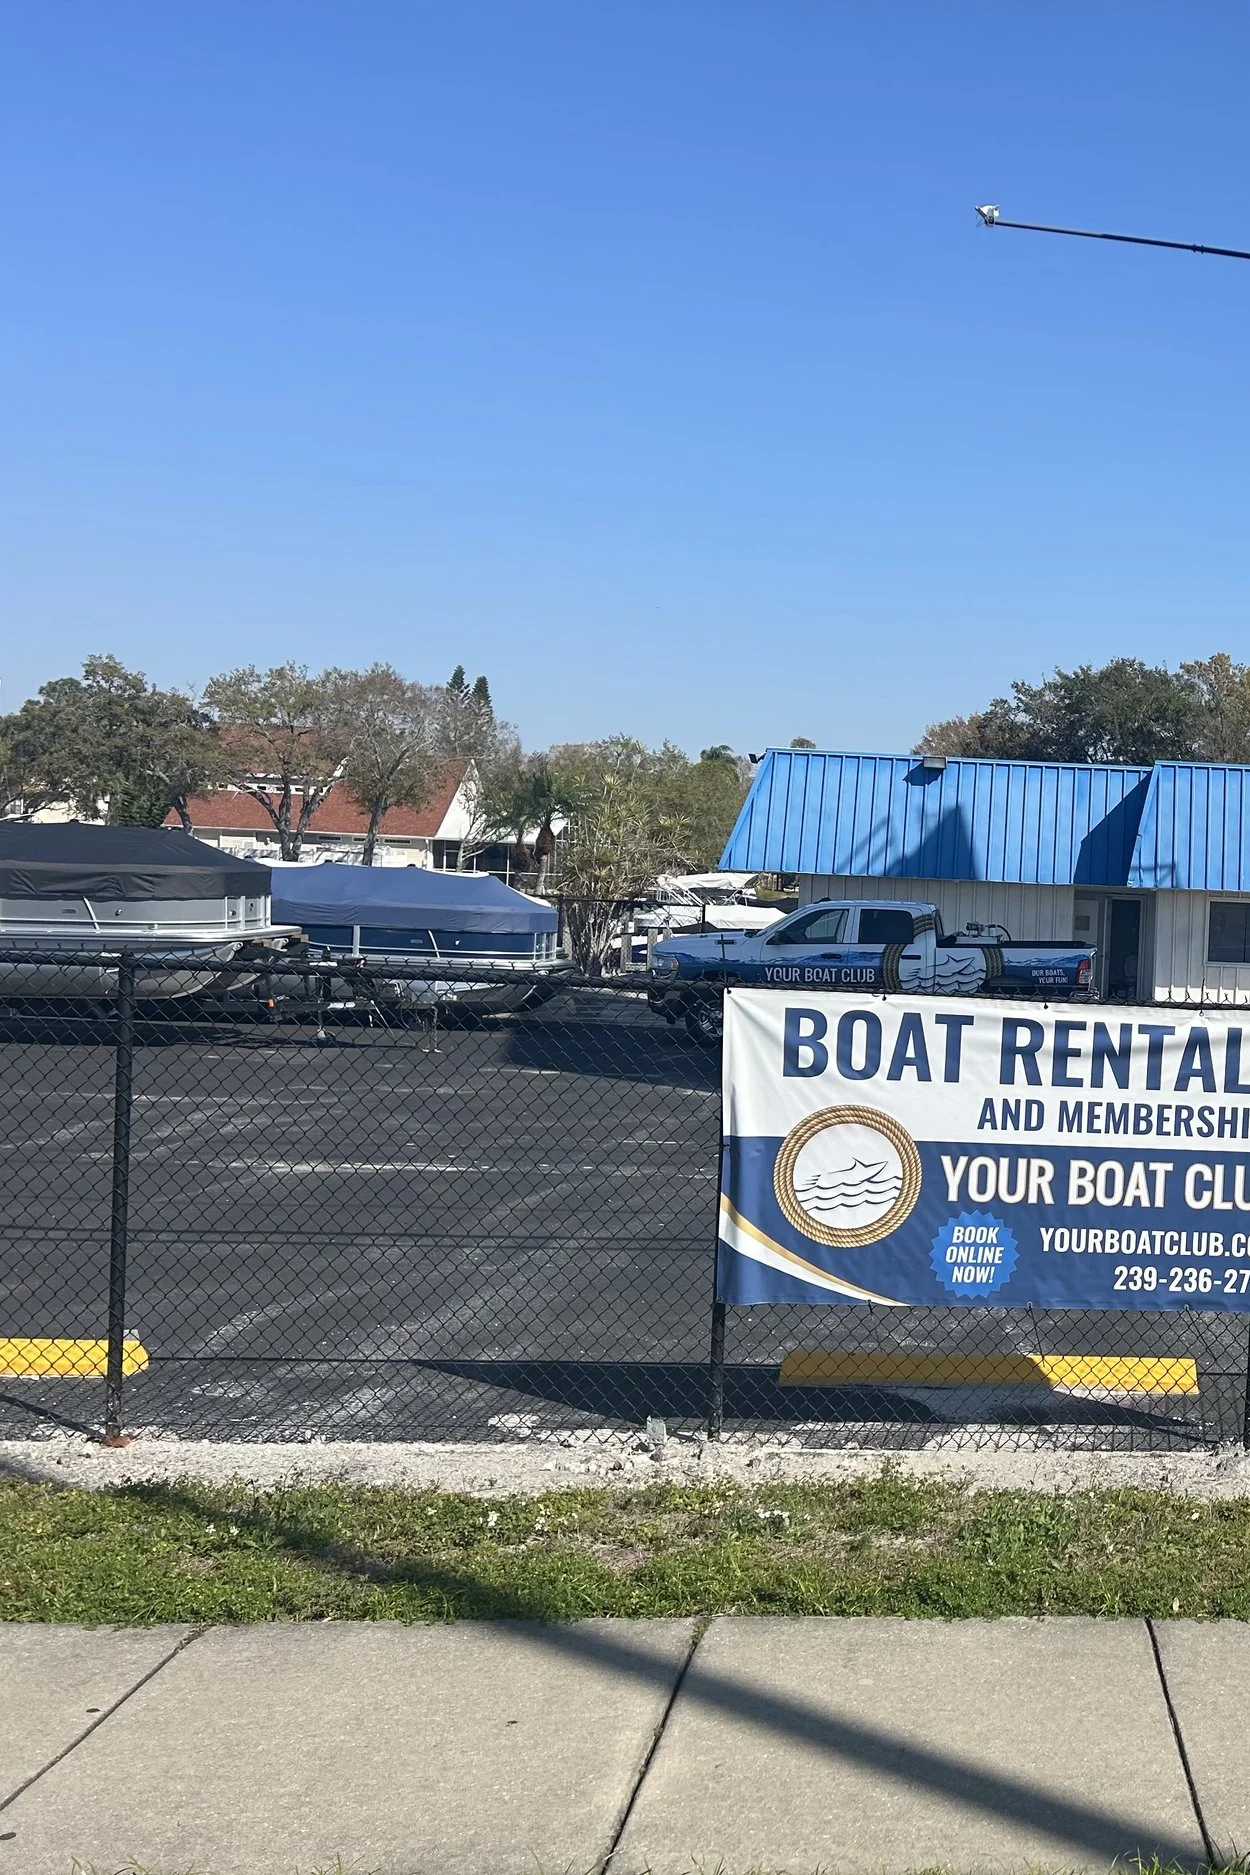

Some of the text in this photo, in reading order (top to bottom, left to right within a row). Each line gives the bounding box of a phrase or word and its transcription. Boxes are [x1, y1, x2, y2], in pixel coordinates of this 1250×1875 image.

[765, 967, 875, 983] YOUR BOAT CLUB
[1031, 969, 1044, 977] OUR
[783, 1007, 975, 1083] BOAT
[977, 1097, 1045, 1131] AND
[940, 1155, 1055, 1205] YOUR
[1067, 1159, 1174, 1208] BOAT
[952, 1226, 1000, 1244] BOOK
[945, 1246, 1004, 1264] ONLINE
[951, 1265, 996, 1284] NOW!
